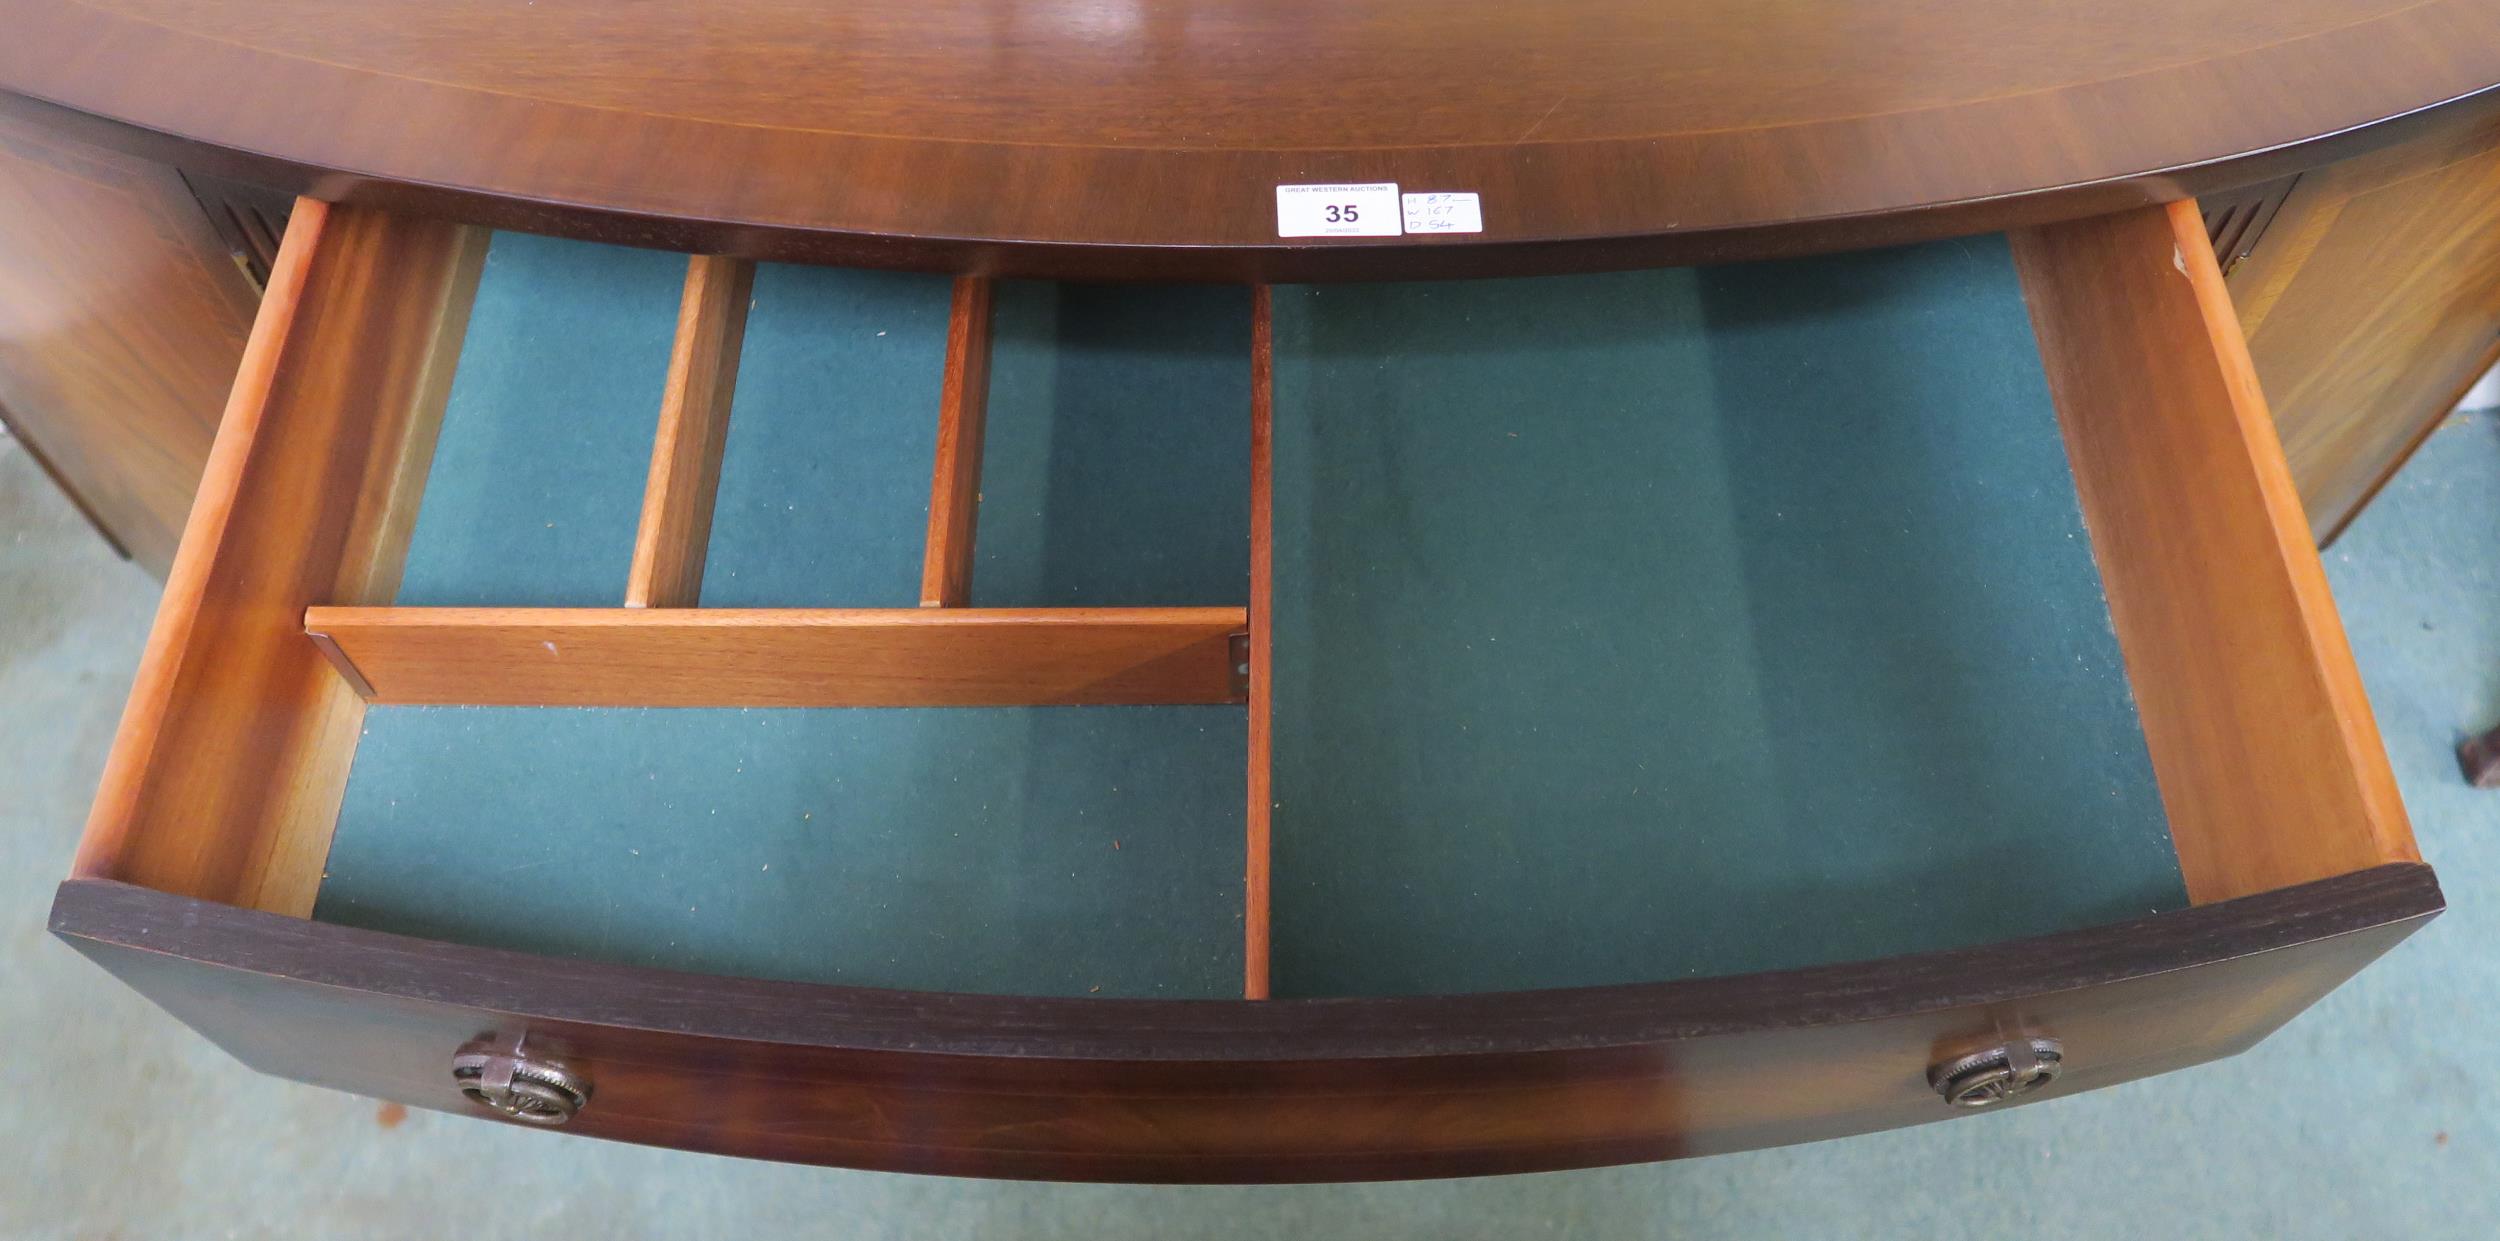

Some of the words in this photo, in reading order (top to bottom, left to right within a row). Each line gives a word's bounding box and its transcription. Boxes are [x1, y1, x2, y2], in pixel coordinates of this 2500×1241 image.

[1325, 204, 1359, 223] 35
[1428, 206, 1453, 216] 167
[1409, 221, 1422, 230] D
[1428, 219, 1455, 230] 54
